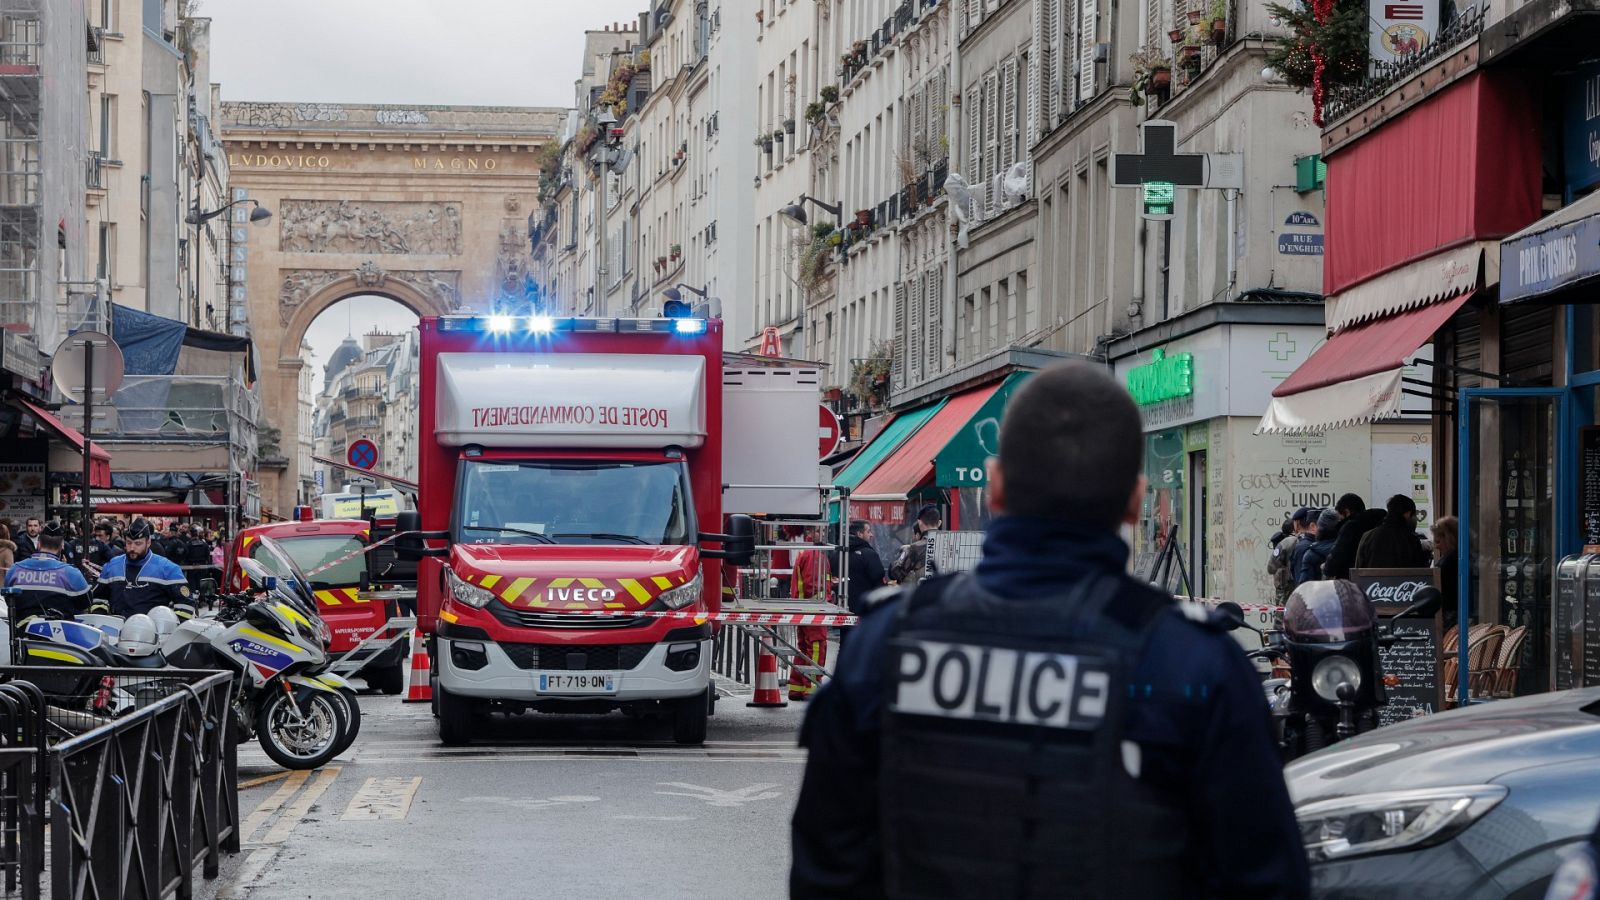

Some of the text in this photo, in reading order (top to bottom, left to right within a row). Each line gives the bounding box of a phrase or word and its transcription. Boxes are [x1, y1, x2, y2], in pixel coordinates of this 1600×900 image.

[229, 154, 497, 170] LVDOVICO MAGNO
[1293, 235, 1313, 243] RUE
[1279, 243, 1325, 253] D'ENGHIEN
[1519, 246, 1540, 287] PRIX
[1287, 456, 1322, 466] Docteur
[1279, 467, 1330, 478] J. LEVINE
[1273, 492, 1336, 508] du LUNDI
[1266, 517, 1281, 526] au
[18, 571, 57, 584] POLICE
[548, 588, 616, 602] IVECO
[1366, 581, 1427, 602] Coca-Col
[248, 642, 279, 657] POLICE
[890, 641, 1111, 728] POLICE
